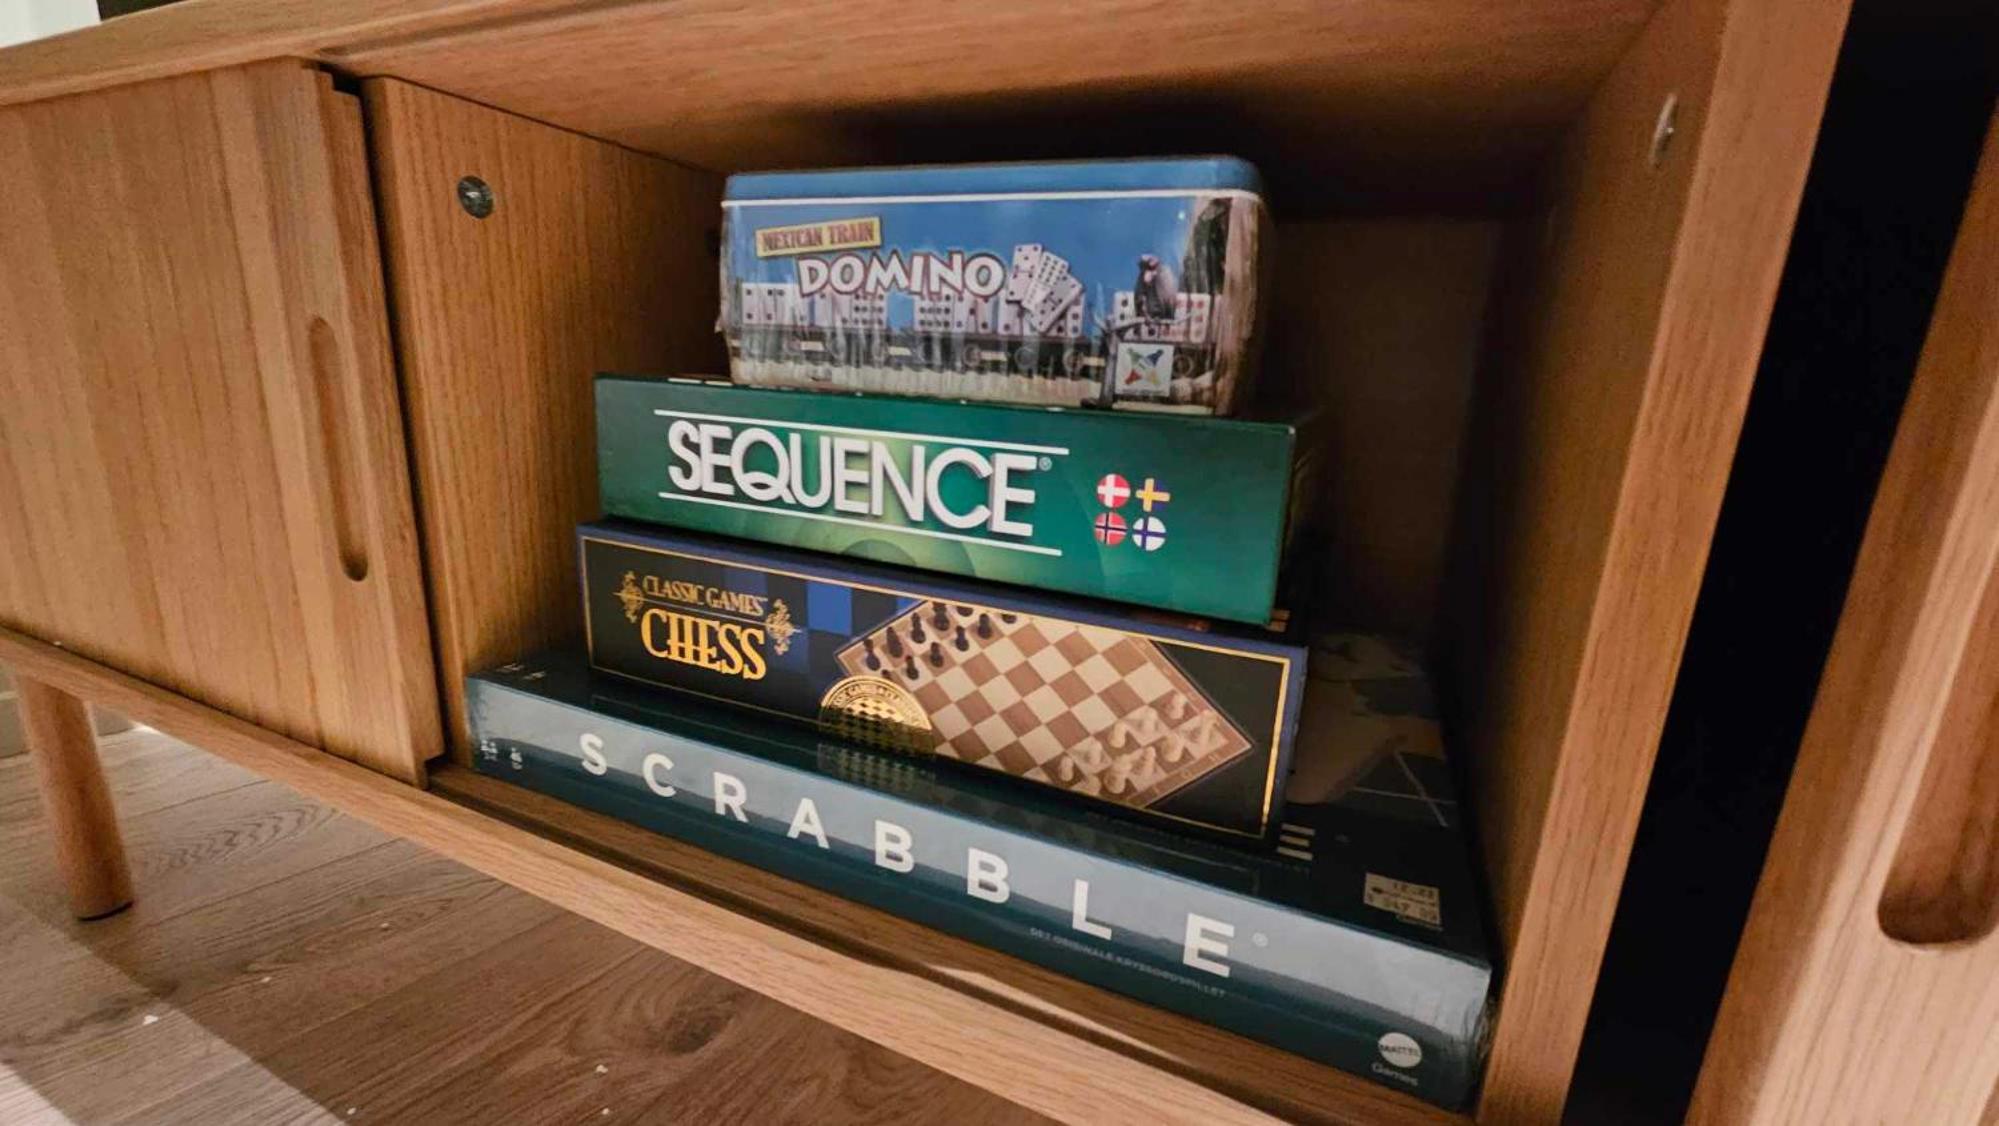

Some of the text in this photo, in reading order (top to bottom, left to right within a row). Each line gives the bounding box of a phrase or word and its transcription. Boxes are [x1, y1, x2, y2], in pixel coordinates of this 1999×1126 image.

[762, 220, 875, 251] MEXICAN TRAIN
[799, 250, 1006, 298] DOMINO
[667, 419, 1040, 537] SEQUENCE
[642, 575, 768, 616] CLASSIC GAMES
[641, 608, 767, 680] CHESS
[579, 732, 1235, 978] SCRABBLE
